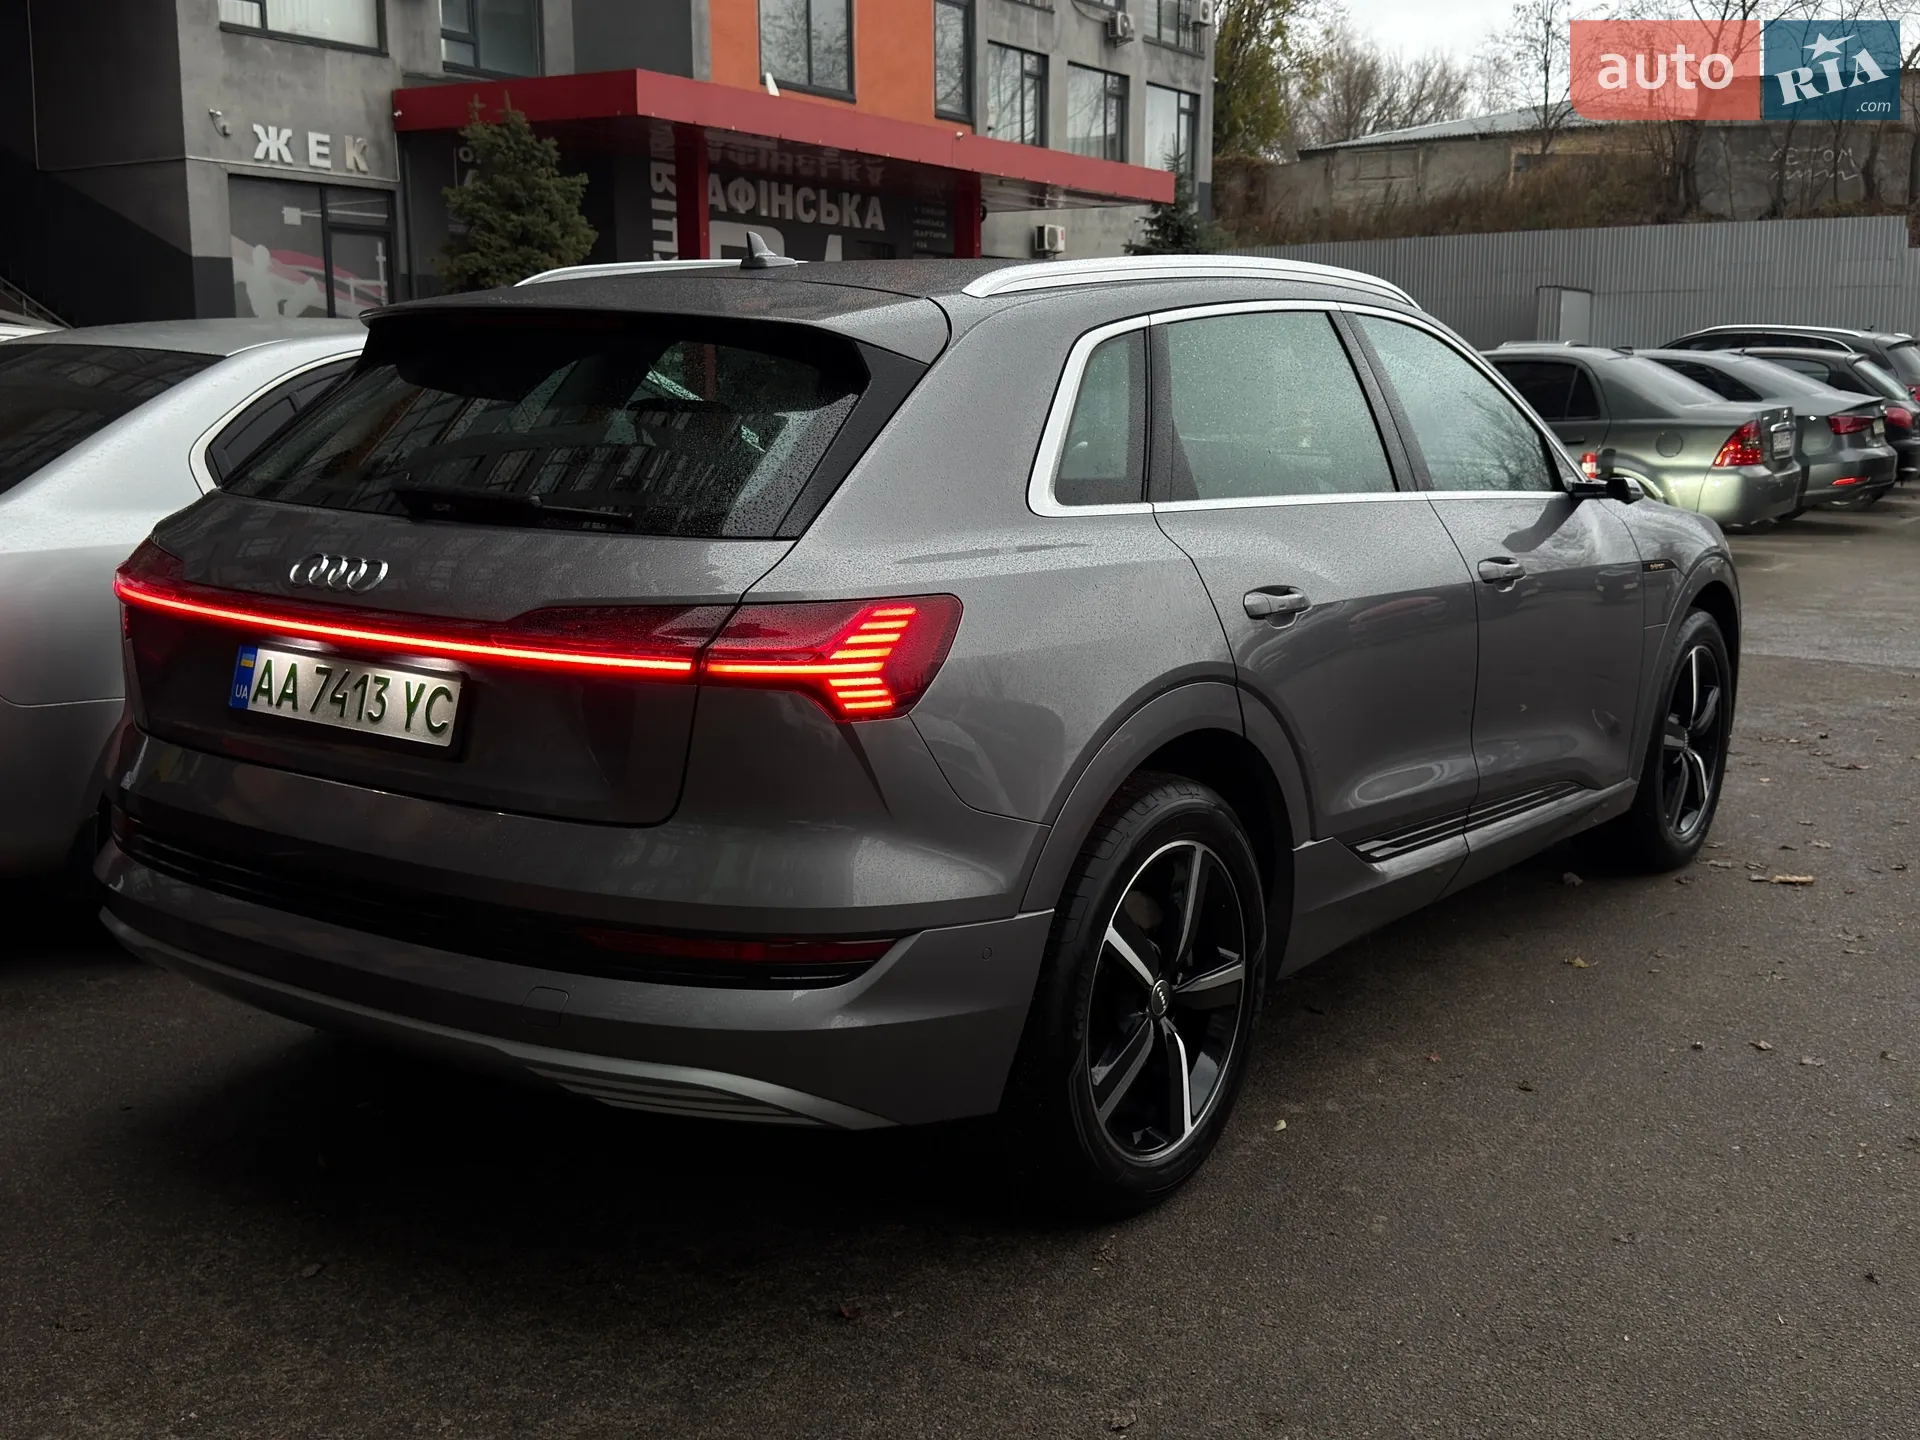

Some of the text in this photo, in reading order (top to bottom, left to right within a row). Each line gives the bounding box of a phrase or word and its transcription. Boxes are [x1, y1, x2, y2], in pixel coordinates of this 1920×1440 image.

[234, 683, 248, 700] UA
[252, 659, 454, 736] AA 7413 YC
